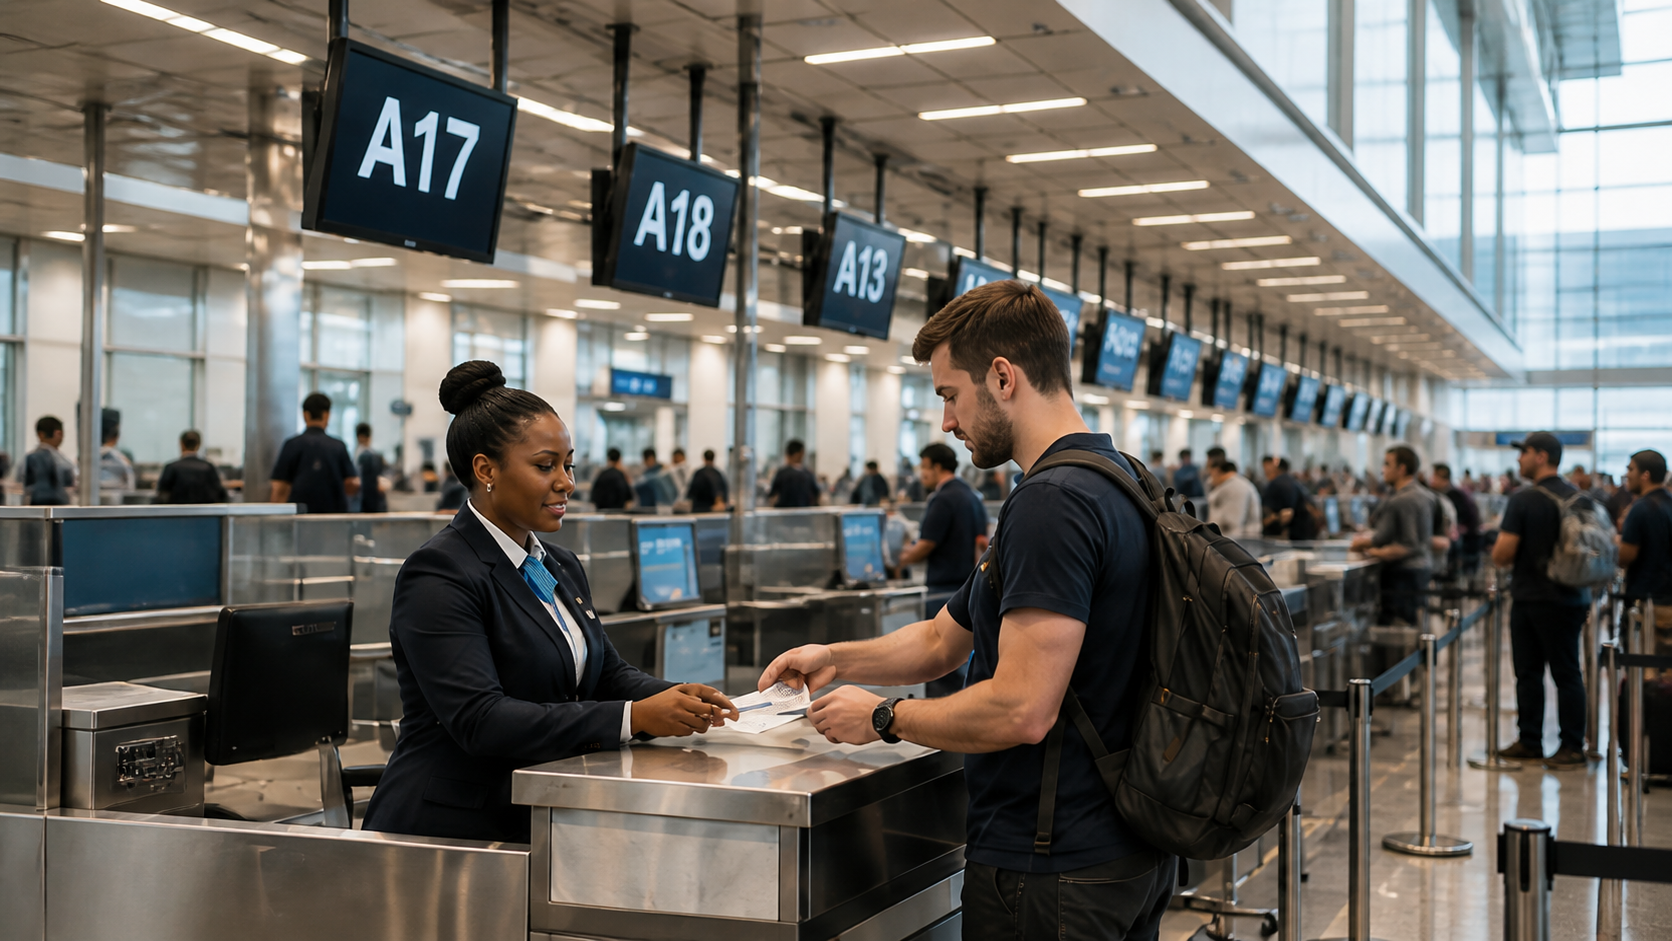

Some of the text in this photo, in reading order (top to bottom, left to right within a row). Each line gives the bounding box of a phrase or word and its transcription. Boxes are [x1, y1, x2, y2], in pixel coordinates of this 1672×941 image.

[357, 96, 480, 200] A17
[633, 181, 714, 261] A18
[833, 239, 888, 303] A13
